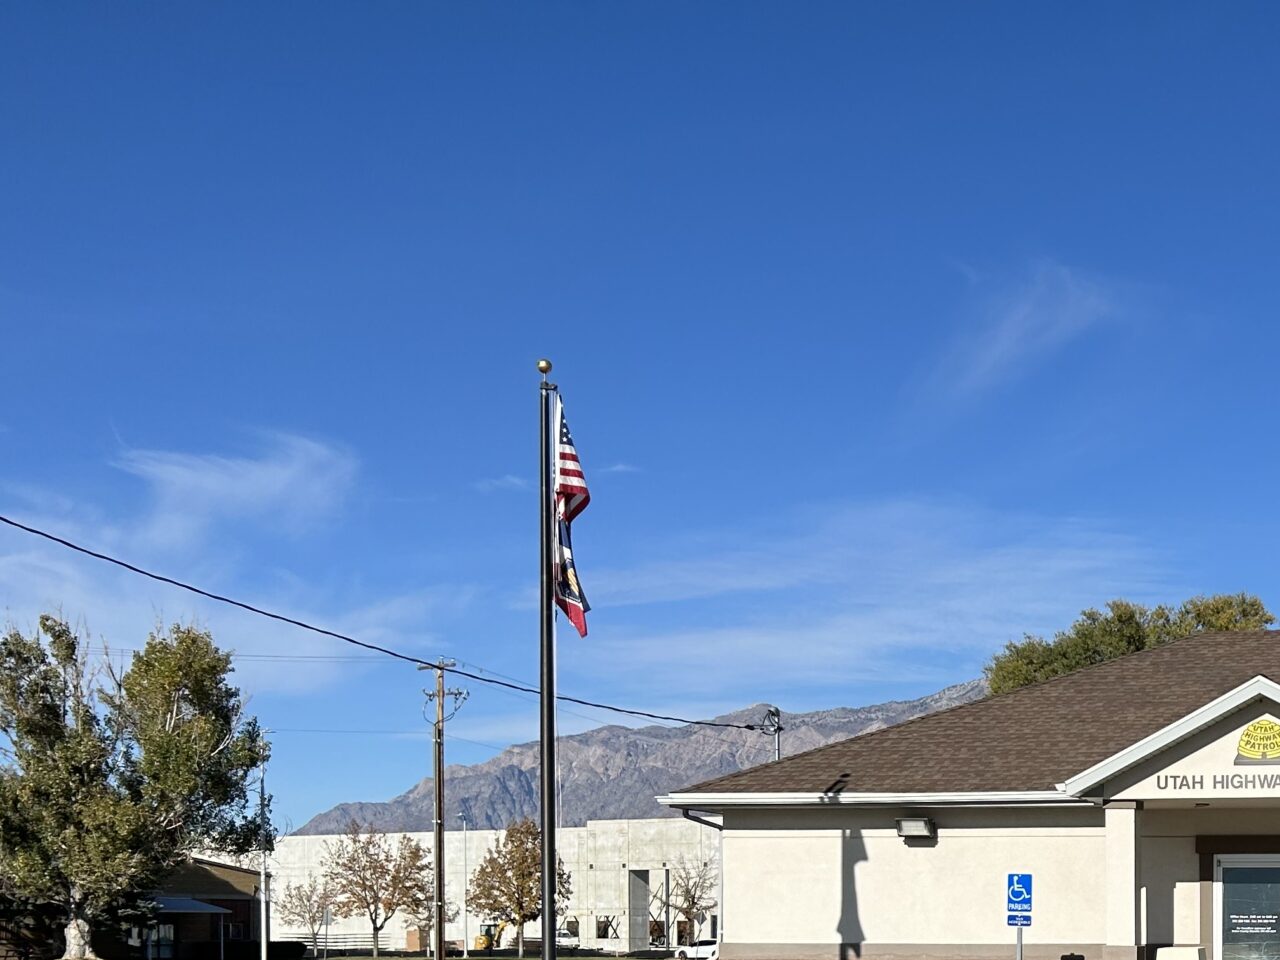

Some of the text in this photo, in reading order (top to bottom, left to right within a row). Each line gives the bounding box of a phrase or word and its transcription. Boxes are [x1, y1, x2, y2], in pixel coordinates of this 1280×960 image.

[1244, 732, 1280, 742] HIGHWAY
[1244, 740, 1280, 750] PATROL
[1156, 775, 1204, 790] UTAH
